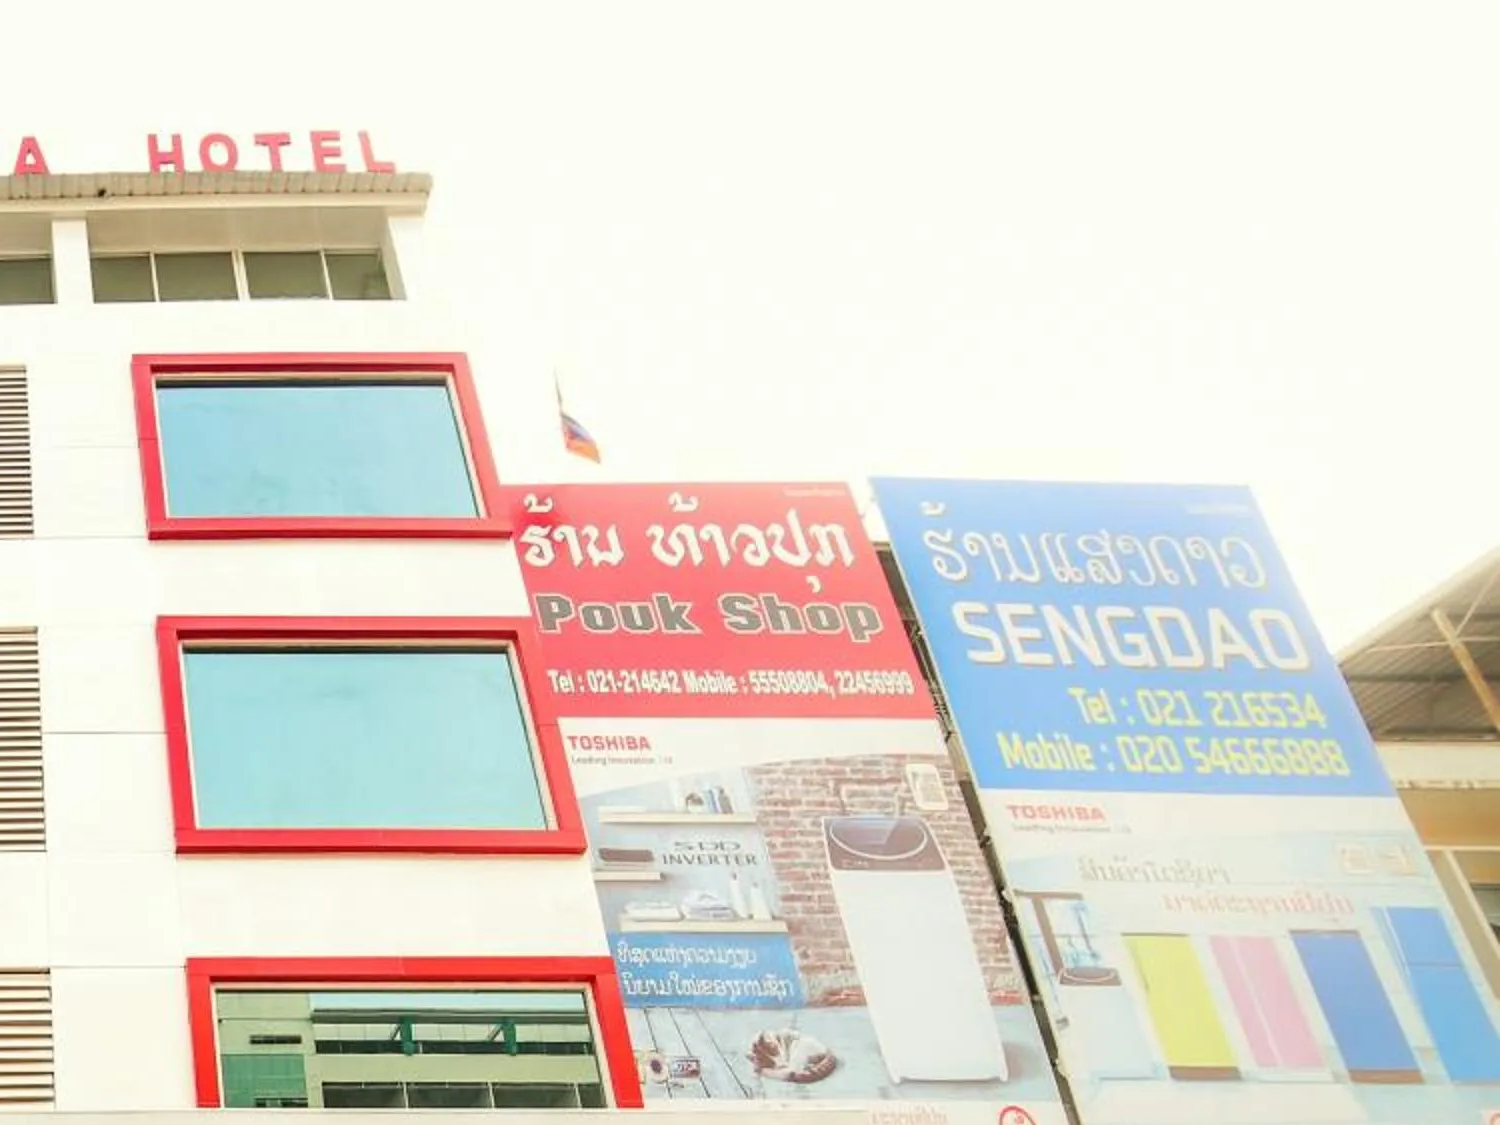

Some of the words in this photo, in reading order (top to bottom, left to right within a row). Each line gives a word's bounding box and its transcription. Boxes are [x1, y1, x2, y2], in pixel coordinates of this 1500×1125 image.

[146, 130, 397, 176] HOTEL
[534, 592, 704, 635] Pouk
[717, 592, 884, 643] Shop
[952, 601, 1312, 671] SENGDAO
[547, 669, 573, 693] Tel
[682, 669, 739, 695] Mobile
[1067, 686, 1117, 725] Tel
[1135, 689, 1204, 728] 021
[1203, 690, 1328, 730] 216534
[567, 735, 652, 751] TOSHIBA
[996, 731, 1097, 771] Mobile
[1115, 735, 1185, 774] 020
[1184, 737, 1351, 778] 54666888
[1006, 804, 1107, 822] TOSHIBA
[661, 853, 759, 867] INVERTER
